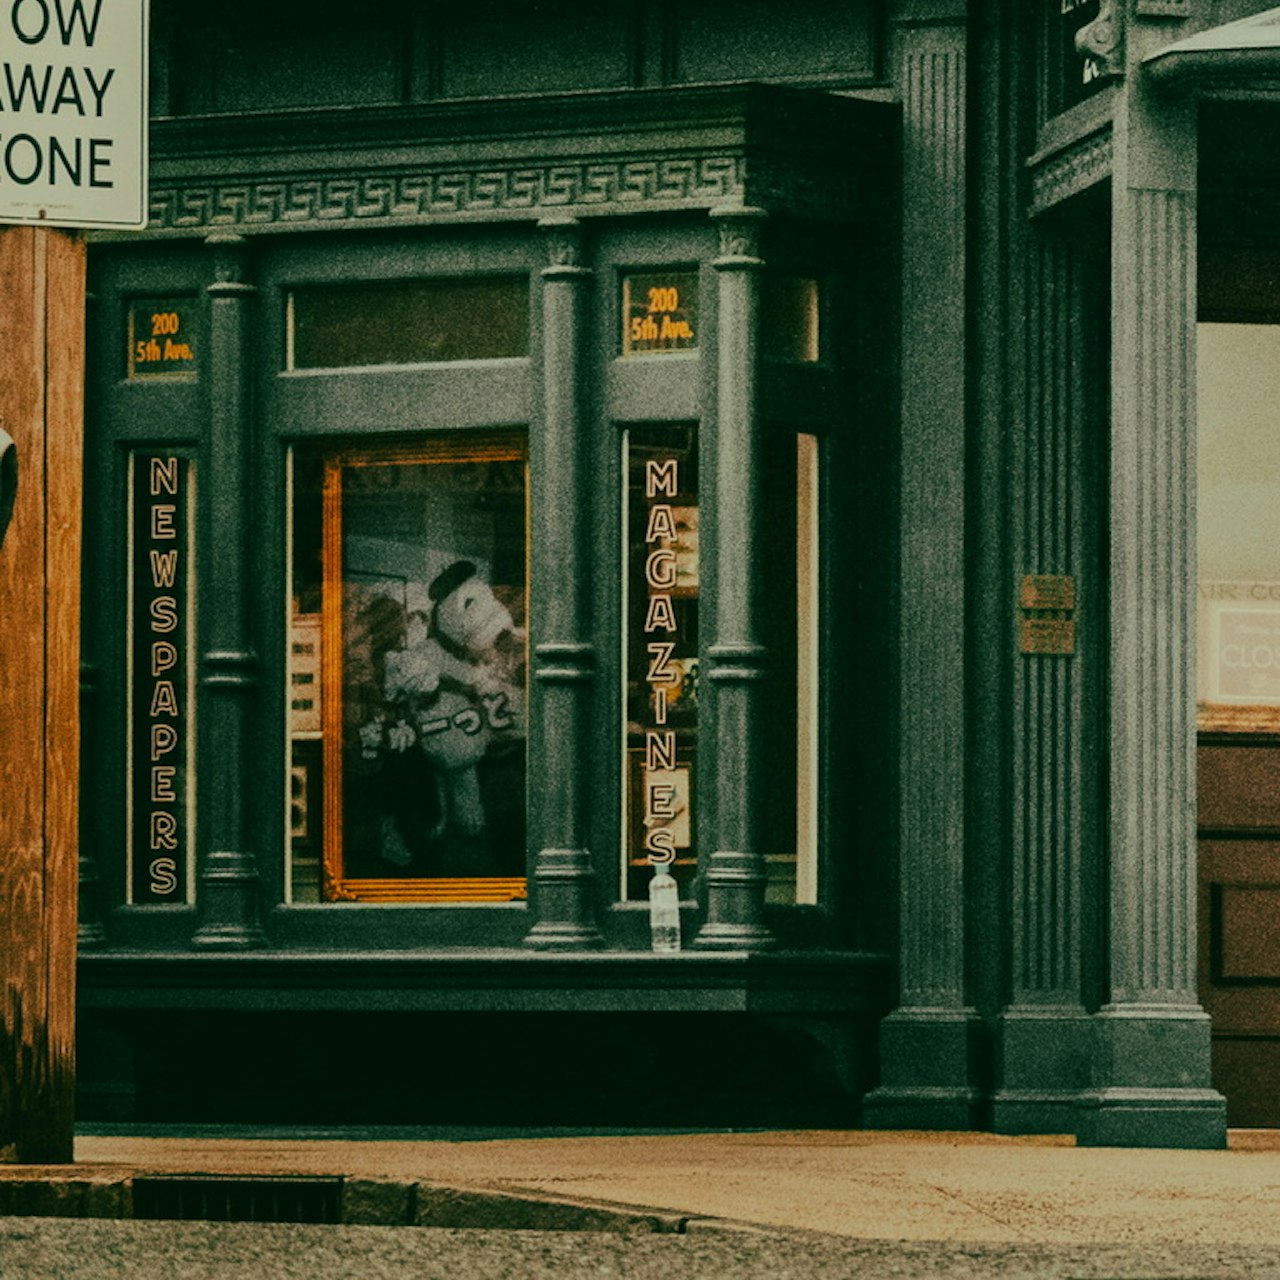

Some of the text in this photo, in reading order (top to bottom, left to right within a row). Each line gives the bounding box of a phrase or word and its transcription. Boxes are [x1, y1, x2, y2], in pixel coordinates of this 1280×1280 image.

[0, 63, 115, 117] WAY
[0, 132, 114, 189] ONE
[651, 286, 679, 313] 200
[151, 312, 179, 337] 200
[632, 315, 693, 341] 5th Ave.
[135, 336, 194, 363] 5th Ave.
[149, 457, 178, 895] NEWSPAPERS
[645, 460, 679, 866] MAGAZINES
